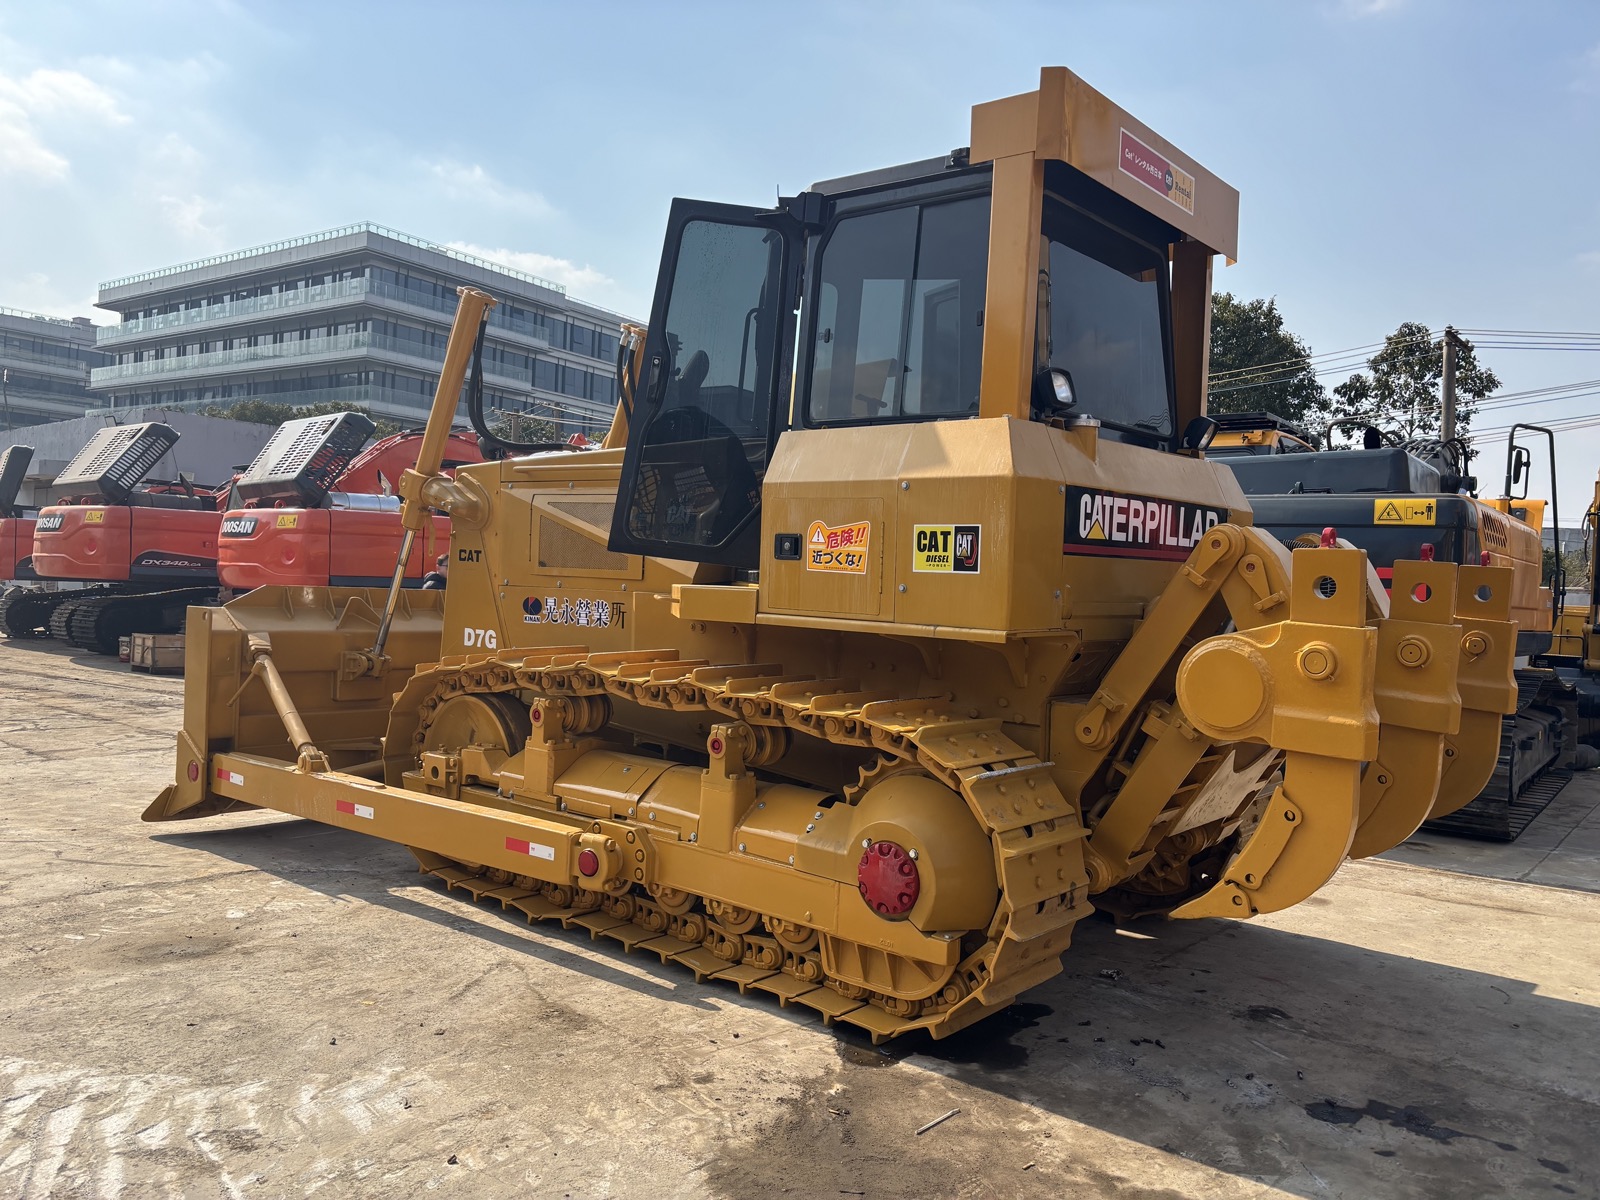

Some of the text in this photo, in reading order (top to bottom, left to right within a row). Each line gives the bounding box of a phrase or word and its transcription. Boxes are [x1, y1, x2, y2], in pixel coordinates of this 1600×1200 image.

[1174, 181, 1191, 200] Rental
[917, 530, 951, 553] CAT
[956, 533, 973, 557] CAT
[458, 549, 482, 562] CAT
[812, 550, 863, 568] 近づくな!
[925, 554, 950, 563] DIESEL
[524, 615, 541, 623] KINAN
[463, 627, 497, 650] D7G
